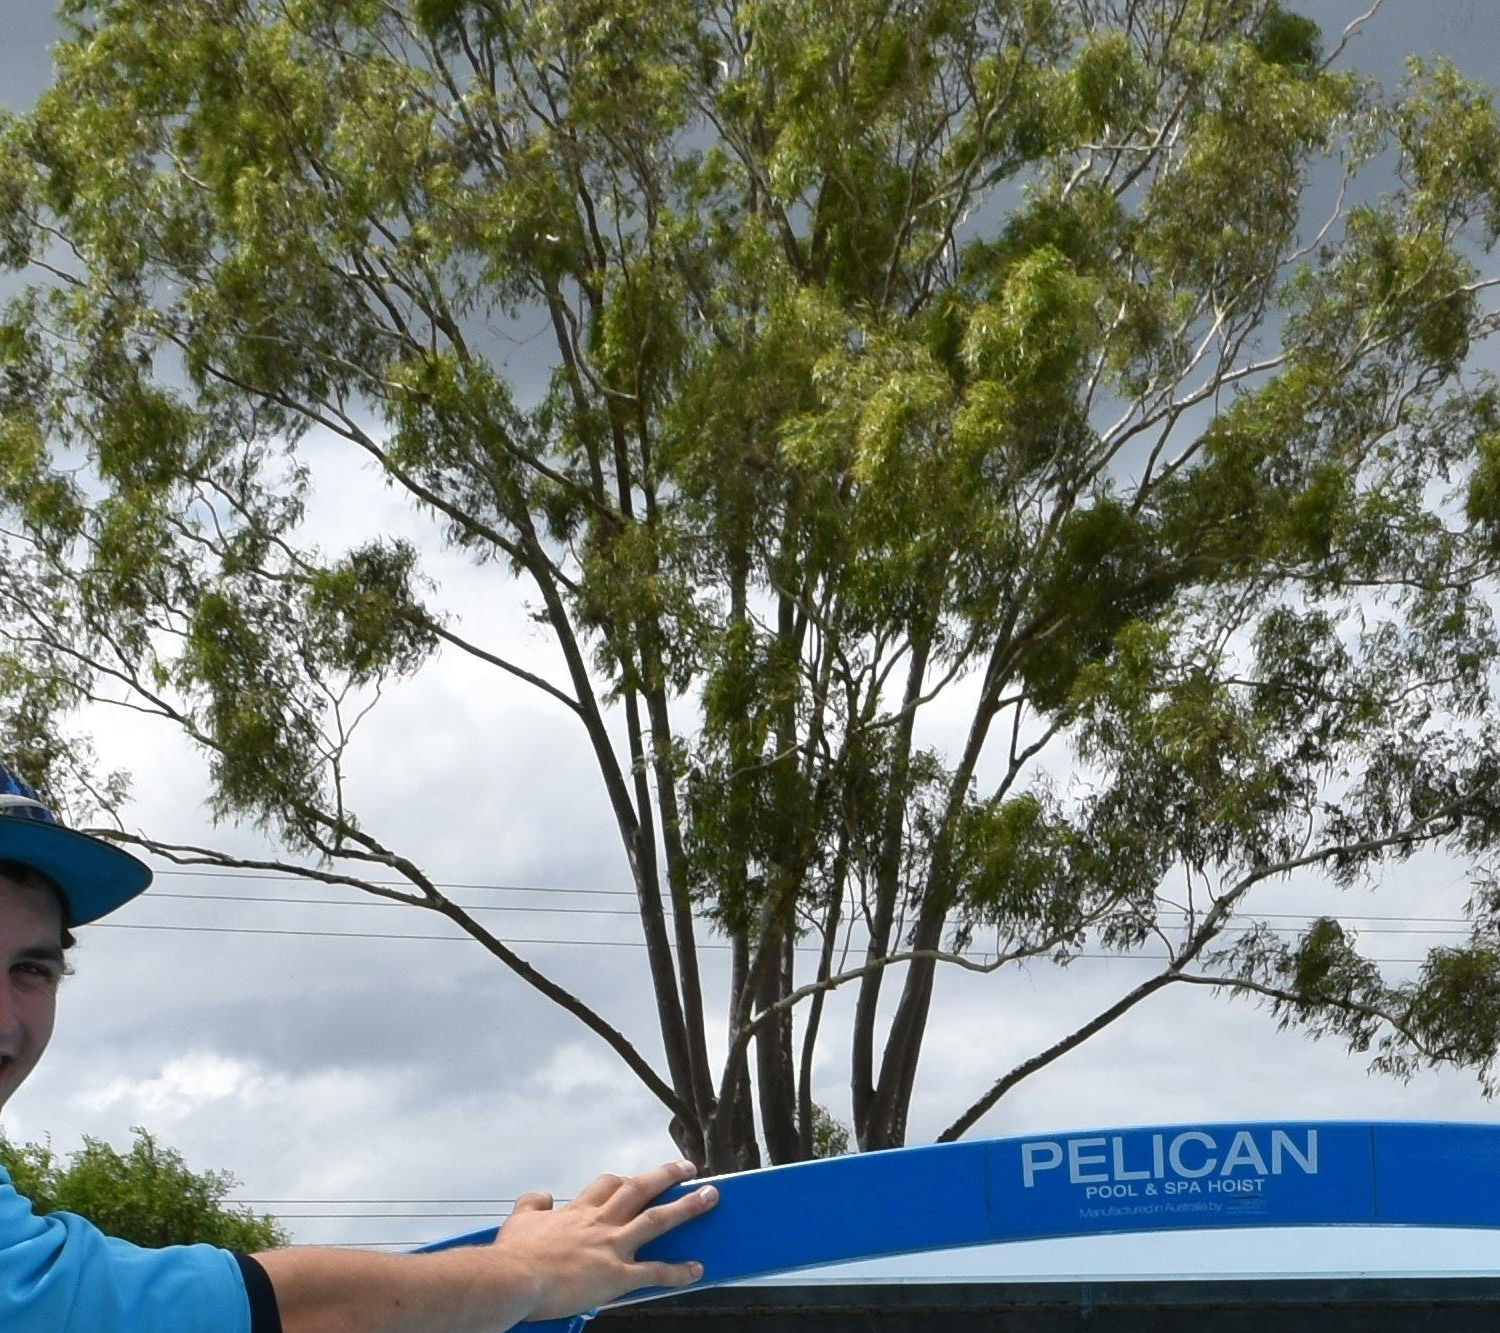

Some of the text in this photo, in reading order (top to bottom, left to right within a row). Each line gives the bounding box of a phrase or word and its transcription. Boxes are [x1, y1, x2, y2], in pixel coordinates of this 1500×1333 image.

[1020, 1129, 1319, 1188] PELICAN
[1086, 1178, 1266, 1199] POOL & SPA HOIST
